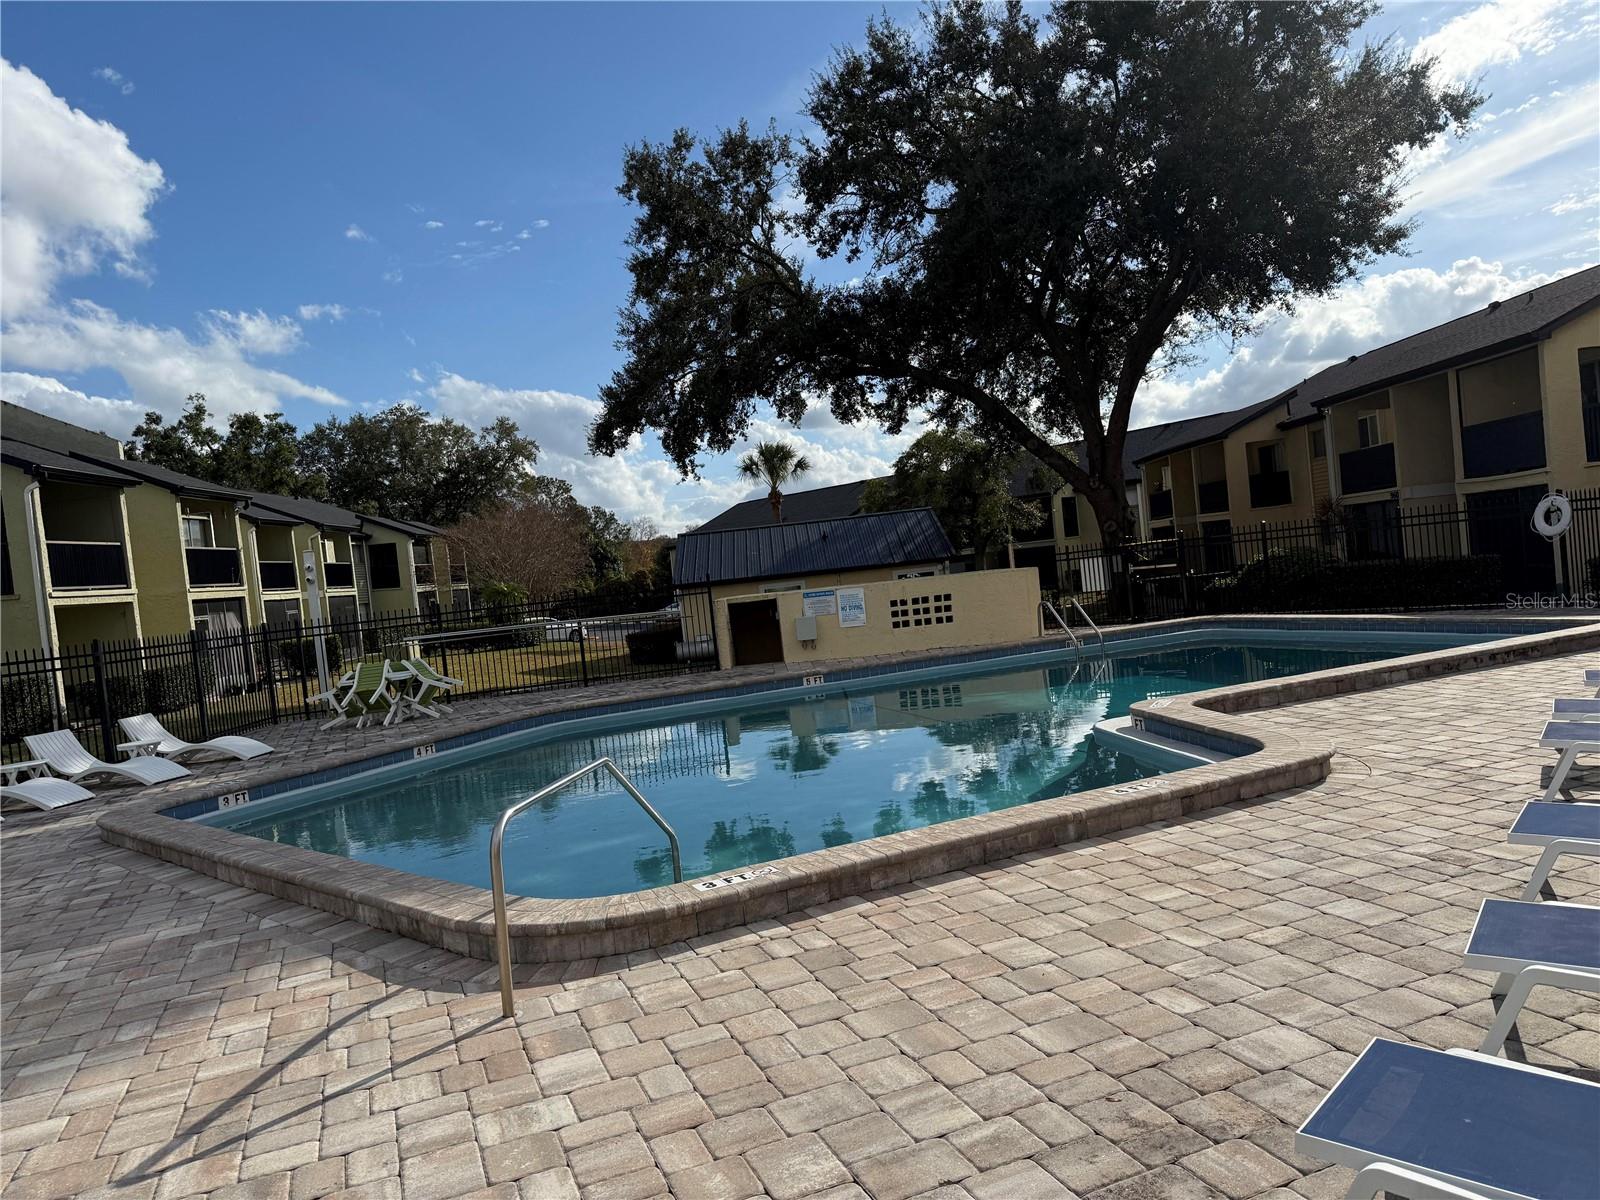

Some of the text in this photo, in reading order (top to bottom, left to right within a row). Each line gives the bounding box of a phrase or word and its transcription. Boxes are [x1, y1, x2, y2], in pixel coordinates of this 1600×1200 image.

[813, 676, 823, 685] FT
[1134, 718, 1144, 731] FT
[416, 744, 434, 757] 4 FT
[222, 791, 247, 806] 3 FT
[701, 881, 718, 889] 3
